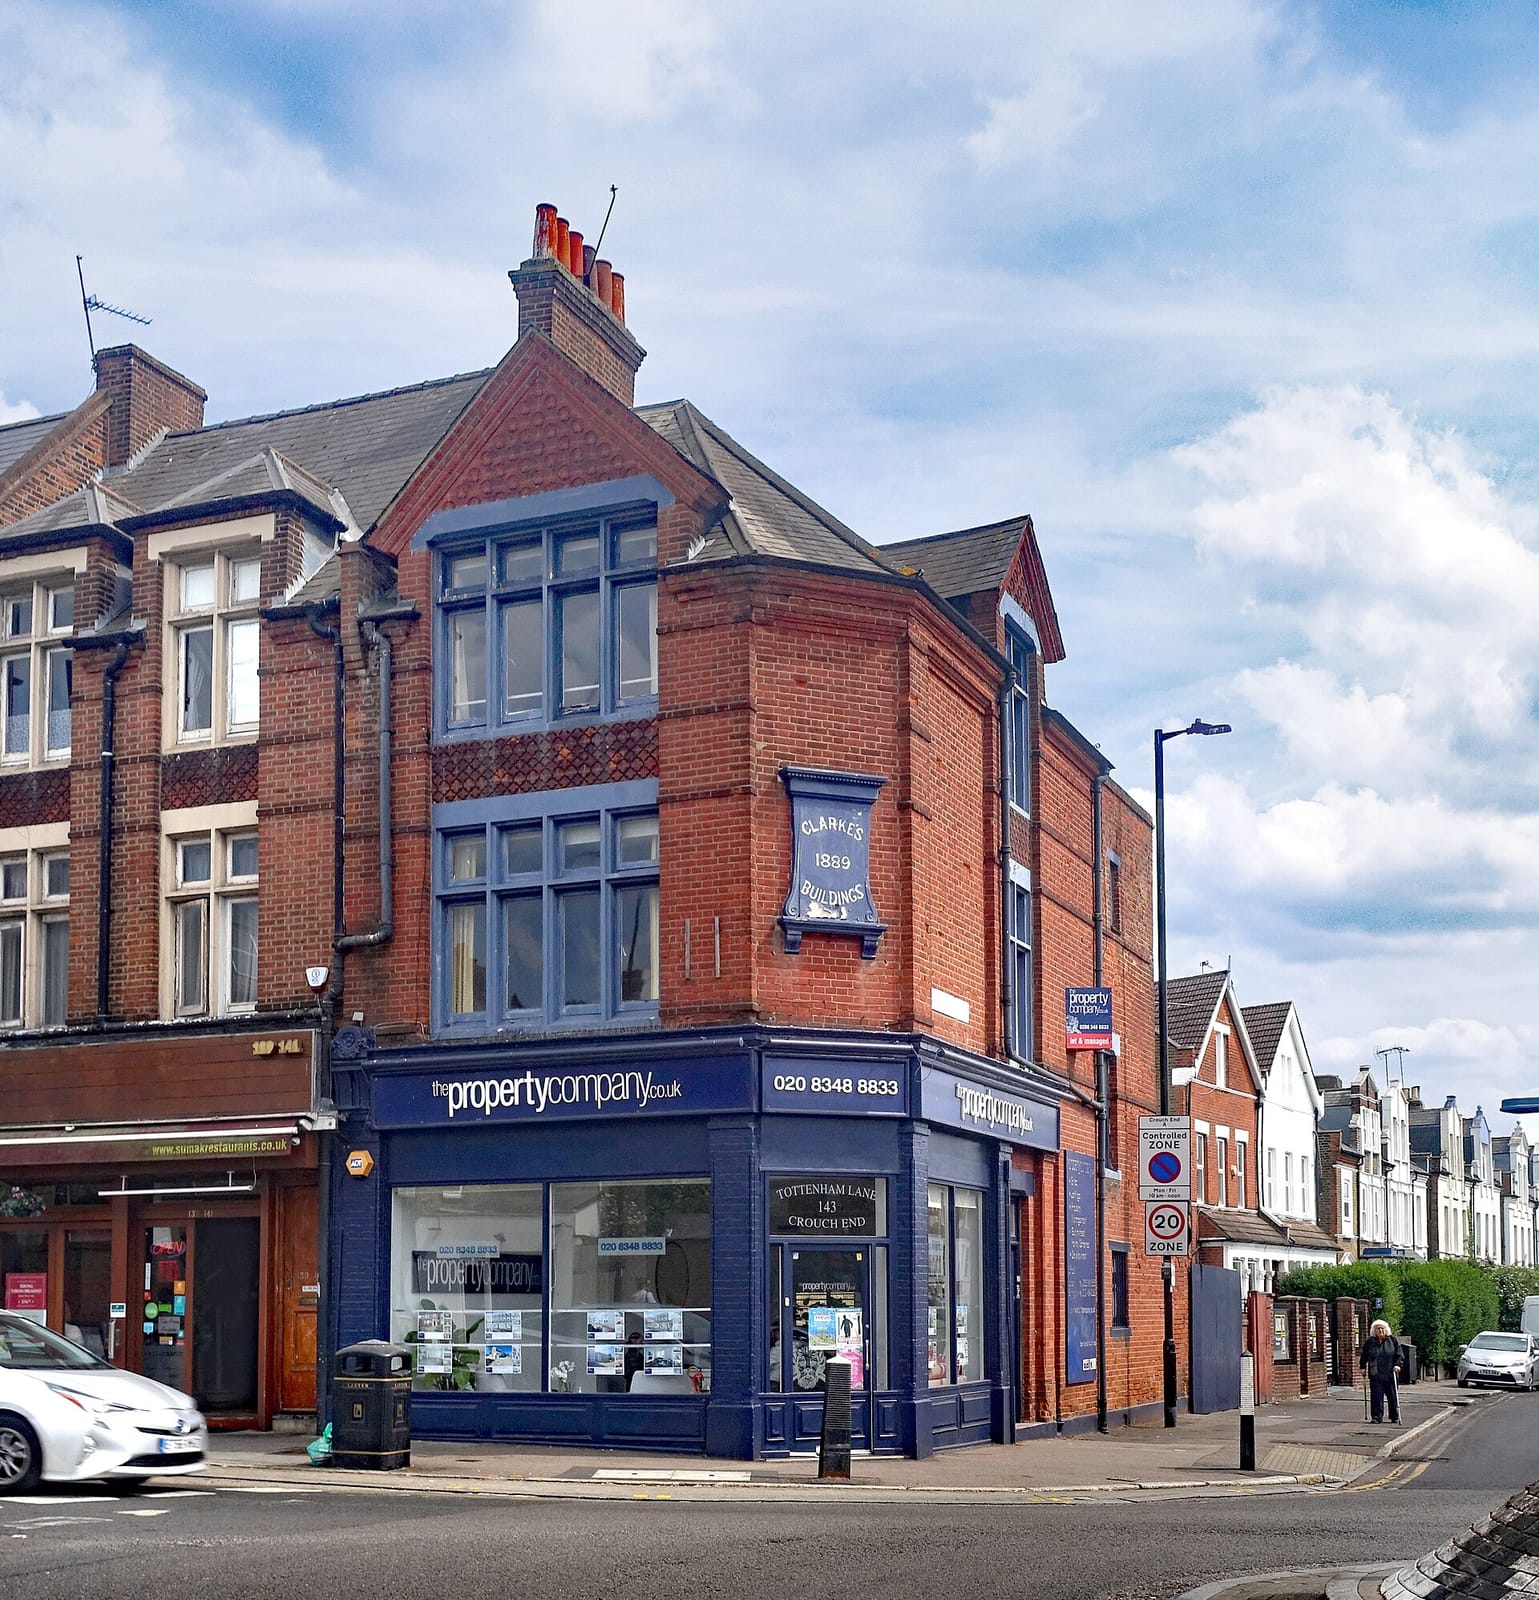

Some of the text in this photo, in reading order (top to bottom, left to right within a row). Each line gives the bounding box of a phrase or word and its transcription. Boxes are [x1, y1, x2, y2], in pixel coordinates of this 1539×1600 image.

[801, 816, 863, 841] CLARKE'S
[815, 853, 851, 869] 1889
[800, 880, 864, 905] BUILDINGS
[1069, 992, 1108, 1006] property
[1084, 1038, 1109, 1046] managed
[774, 1075, 899, 1095] 020 8348 8833
[152, 1139, 287, 1156] www.sumakrestaurants.co.uk
[1149, 1141, 1180, 1149] ZONE
[776, 1184, 878, 1201] TOTTENHAM LANE
[819, 1201, 836, 1213] 143
[788, 1216, 866, 1228] CROUCH END
[1155, 1215, 1179, 1228] 20
[456, 1246, 475, 1254] 8348
[601, 1242, 663, 1251] 020 8348 8833
[1150, 1242, 1183, 1251] ZONE
